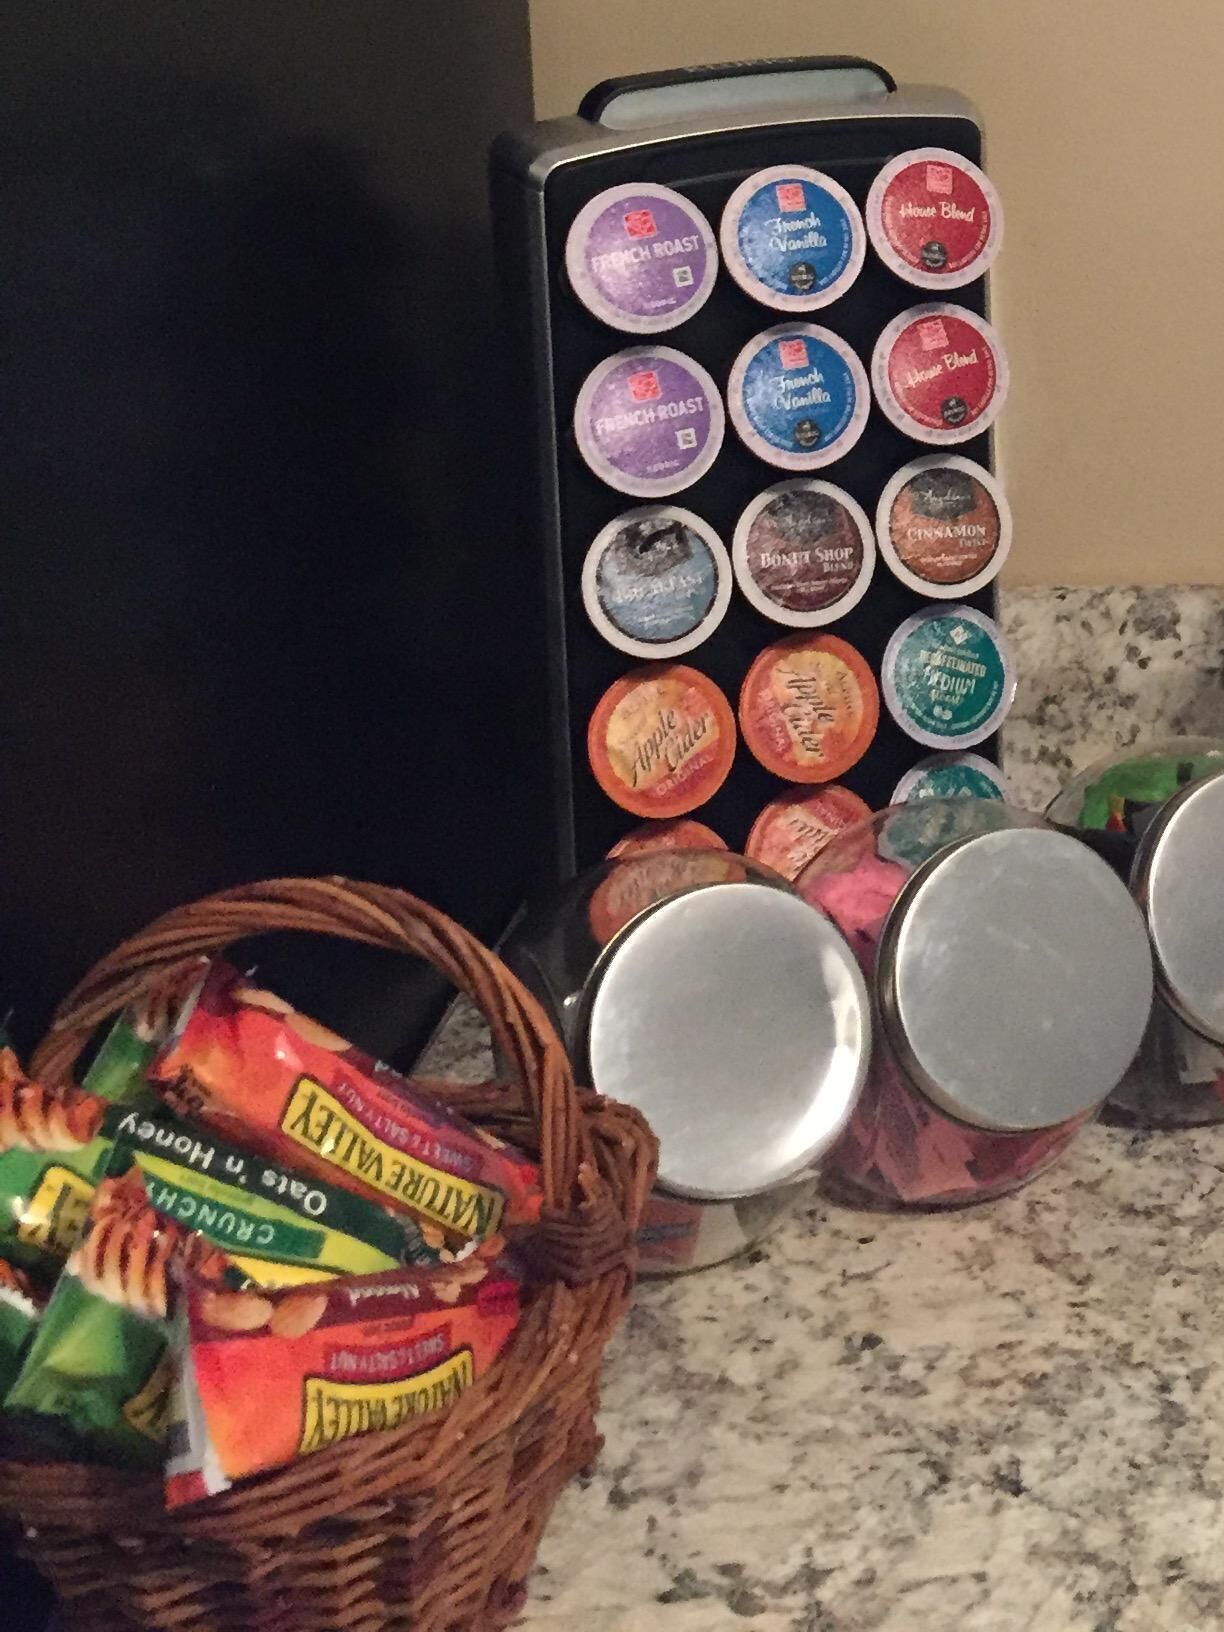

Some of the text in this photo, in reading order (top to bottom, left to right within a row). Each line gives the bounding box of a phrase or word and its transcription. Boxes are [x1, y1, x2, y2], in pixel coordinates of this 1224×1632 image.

[899, 201, 975, 222] House Blend
[591, 235, 699, 273] FRENCH ROAST
[943, 348, 979, 370] Blend
[595, 397, 704, 436] FRENCH ROAST
[906, 524, 987, 541] CINNAMON
[814, 546, 854, 563] SHOP
[631, 709, 676, 787] Apple
[664, 712, 709, 772] Cider
[117, 1111, 216, 1170] Honey
[289, 1090, 495, 1237] NATURE VALLEY
[261, 1169, 328, 1216] Oats
